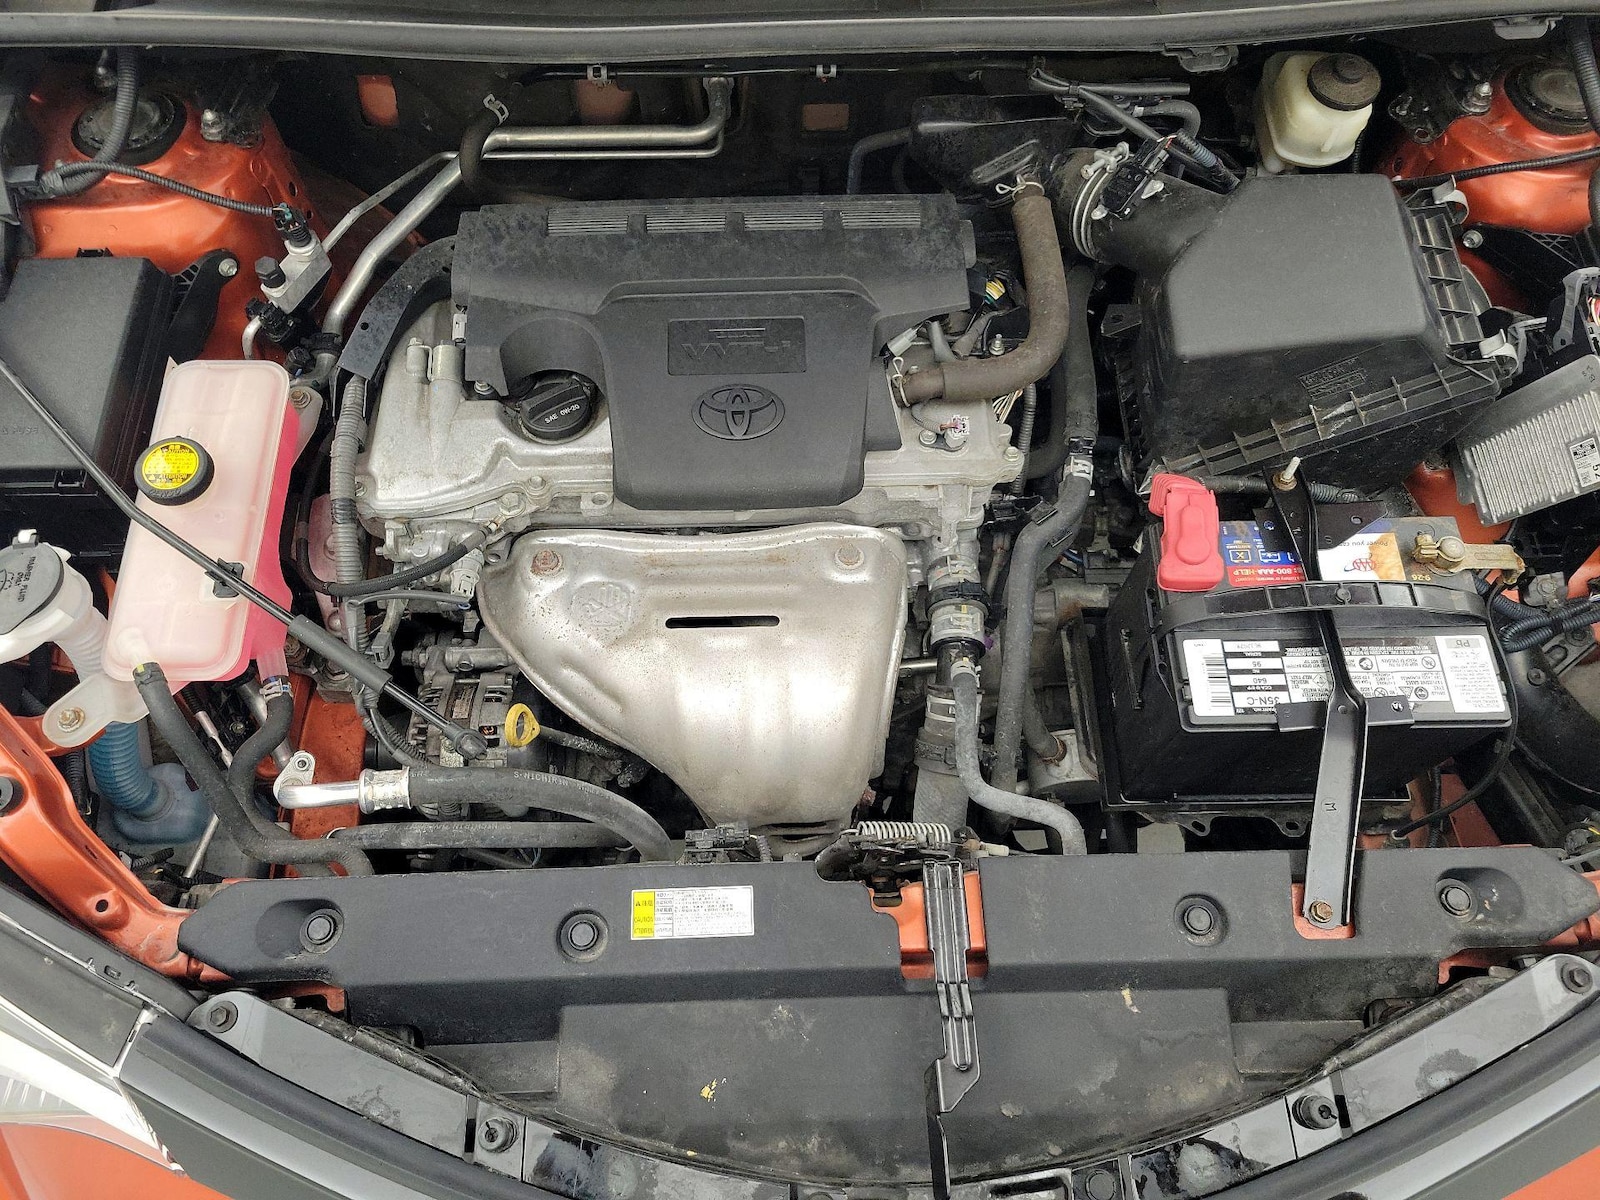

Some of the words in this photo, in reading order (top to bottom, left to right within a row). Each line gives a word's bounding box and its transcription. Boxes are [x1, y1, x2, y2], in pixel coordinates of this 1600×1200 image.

[544, 412, 559, 424] SAE
[1411, 573, 1432, 582] 9-26
[1455, 639, 1470, 648] Pb
[1246, 696, 1280, 706] 35N-C
